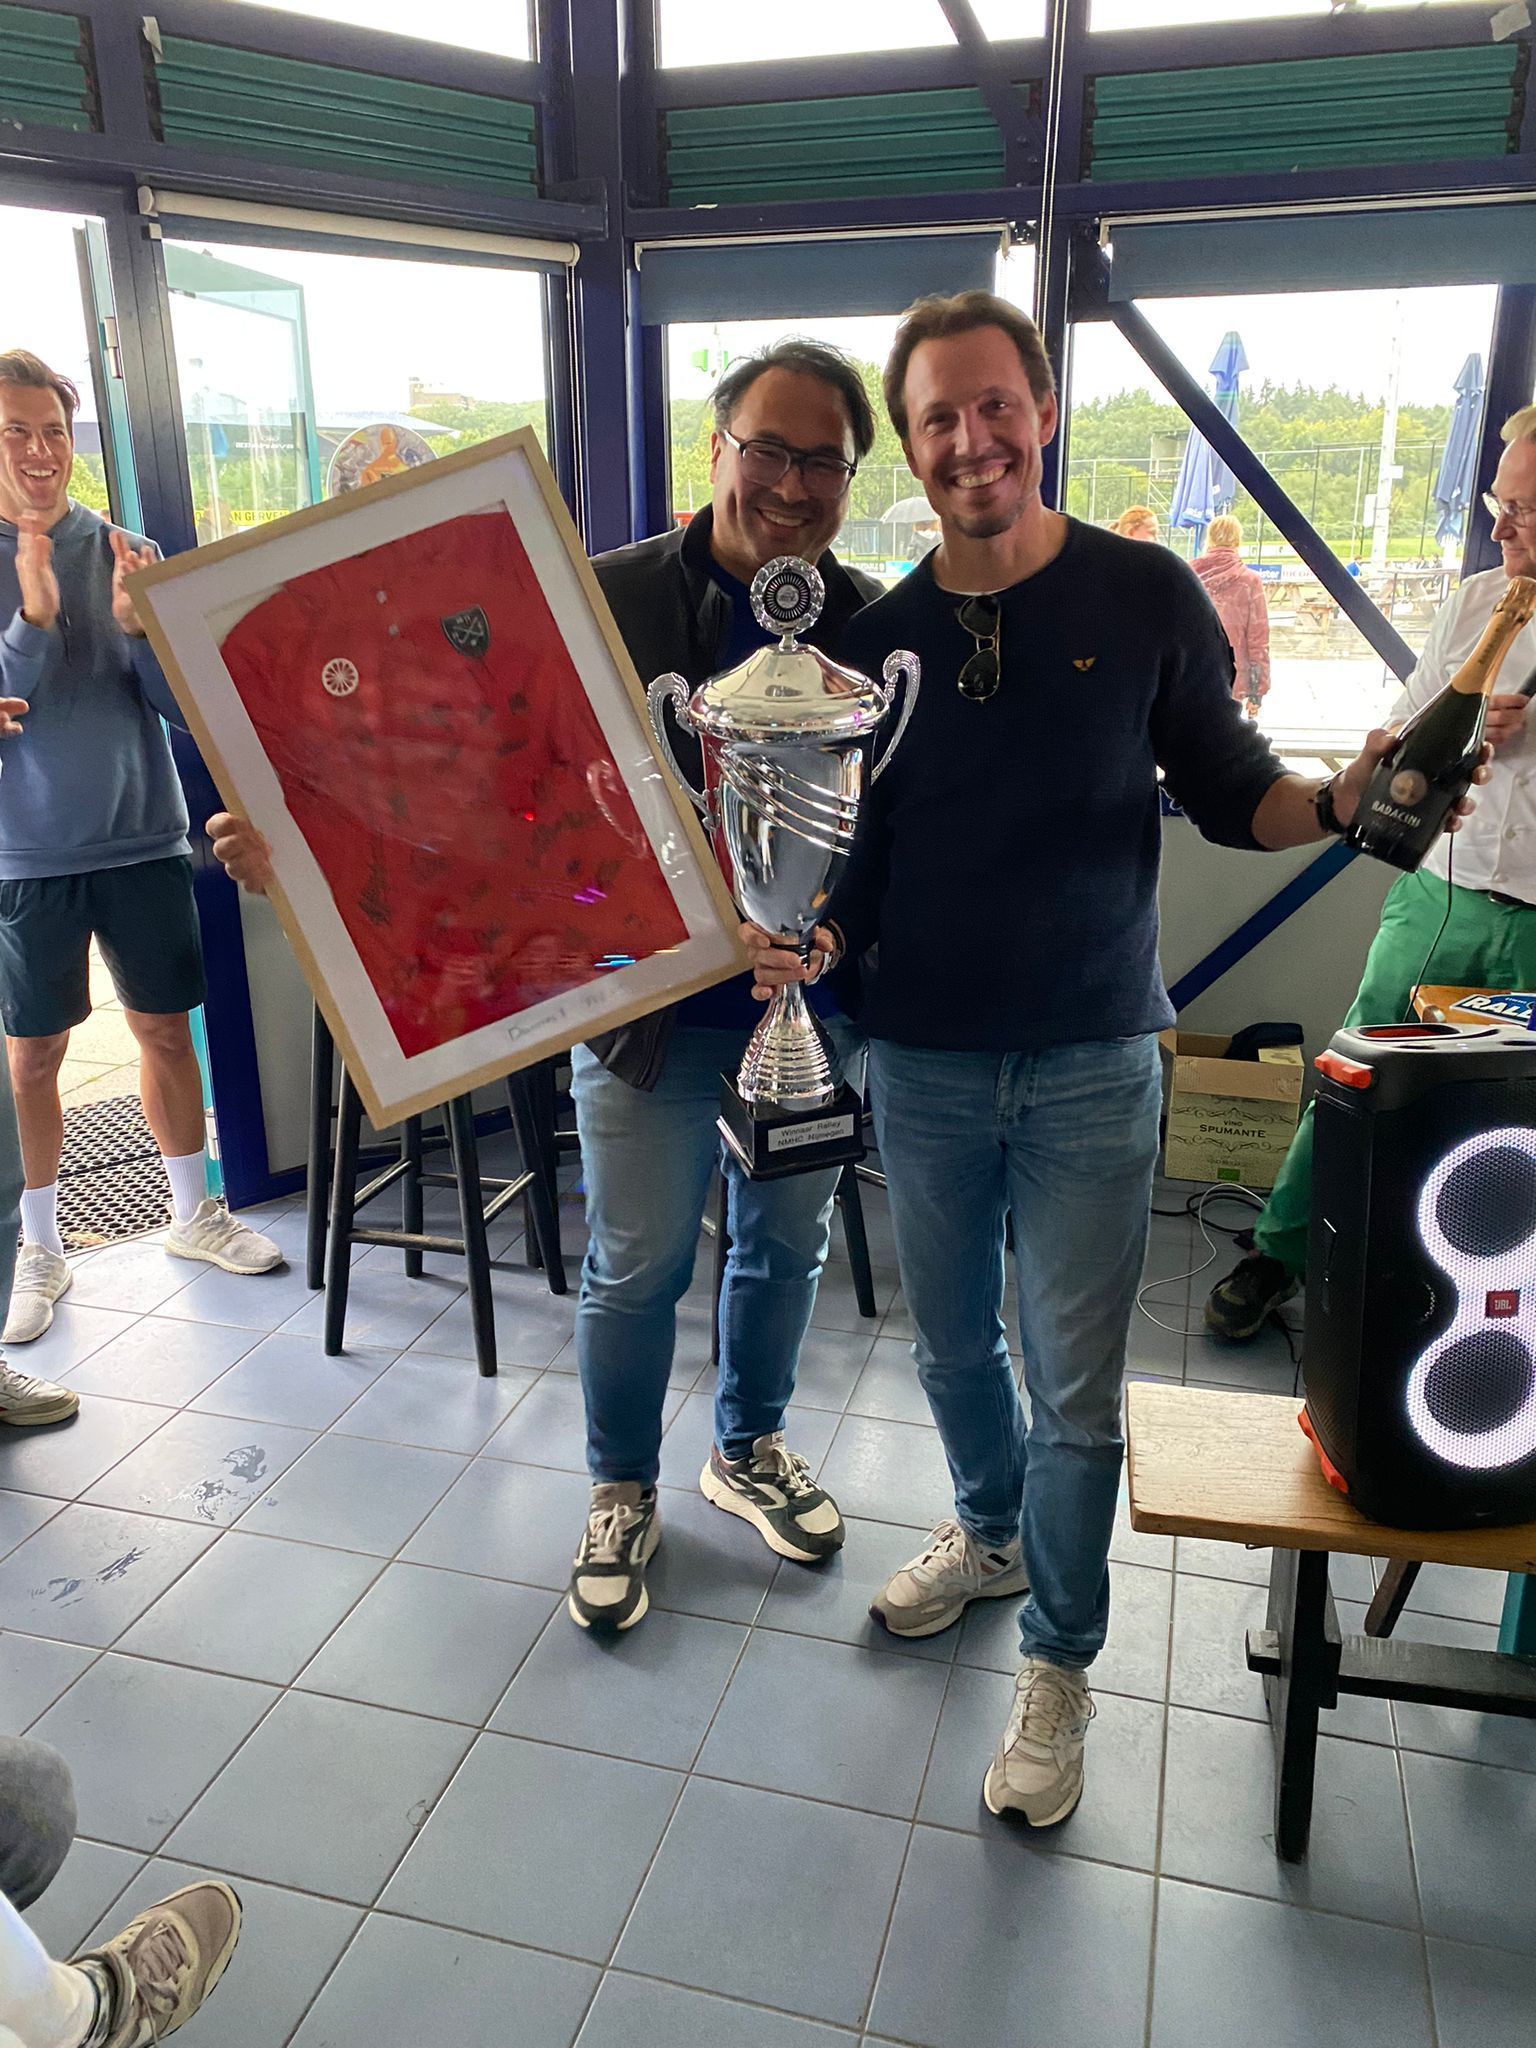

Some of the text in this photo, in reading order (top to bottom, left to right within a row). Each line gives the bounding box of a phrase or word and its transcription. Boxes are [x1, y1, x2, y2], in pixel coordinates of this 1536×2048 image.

[1223, 1119, 1243, 1127] VINO
[1199, 1123, 1266, 1138] SPUMANTE
[1494, 1299, 1512, 1310] JBL
